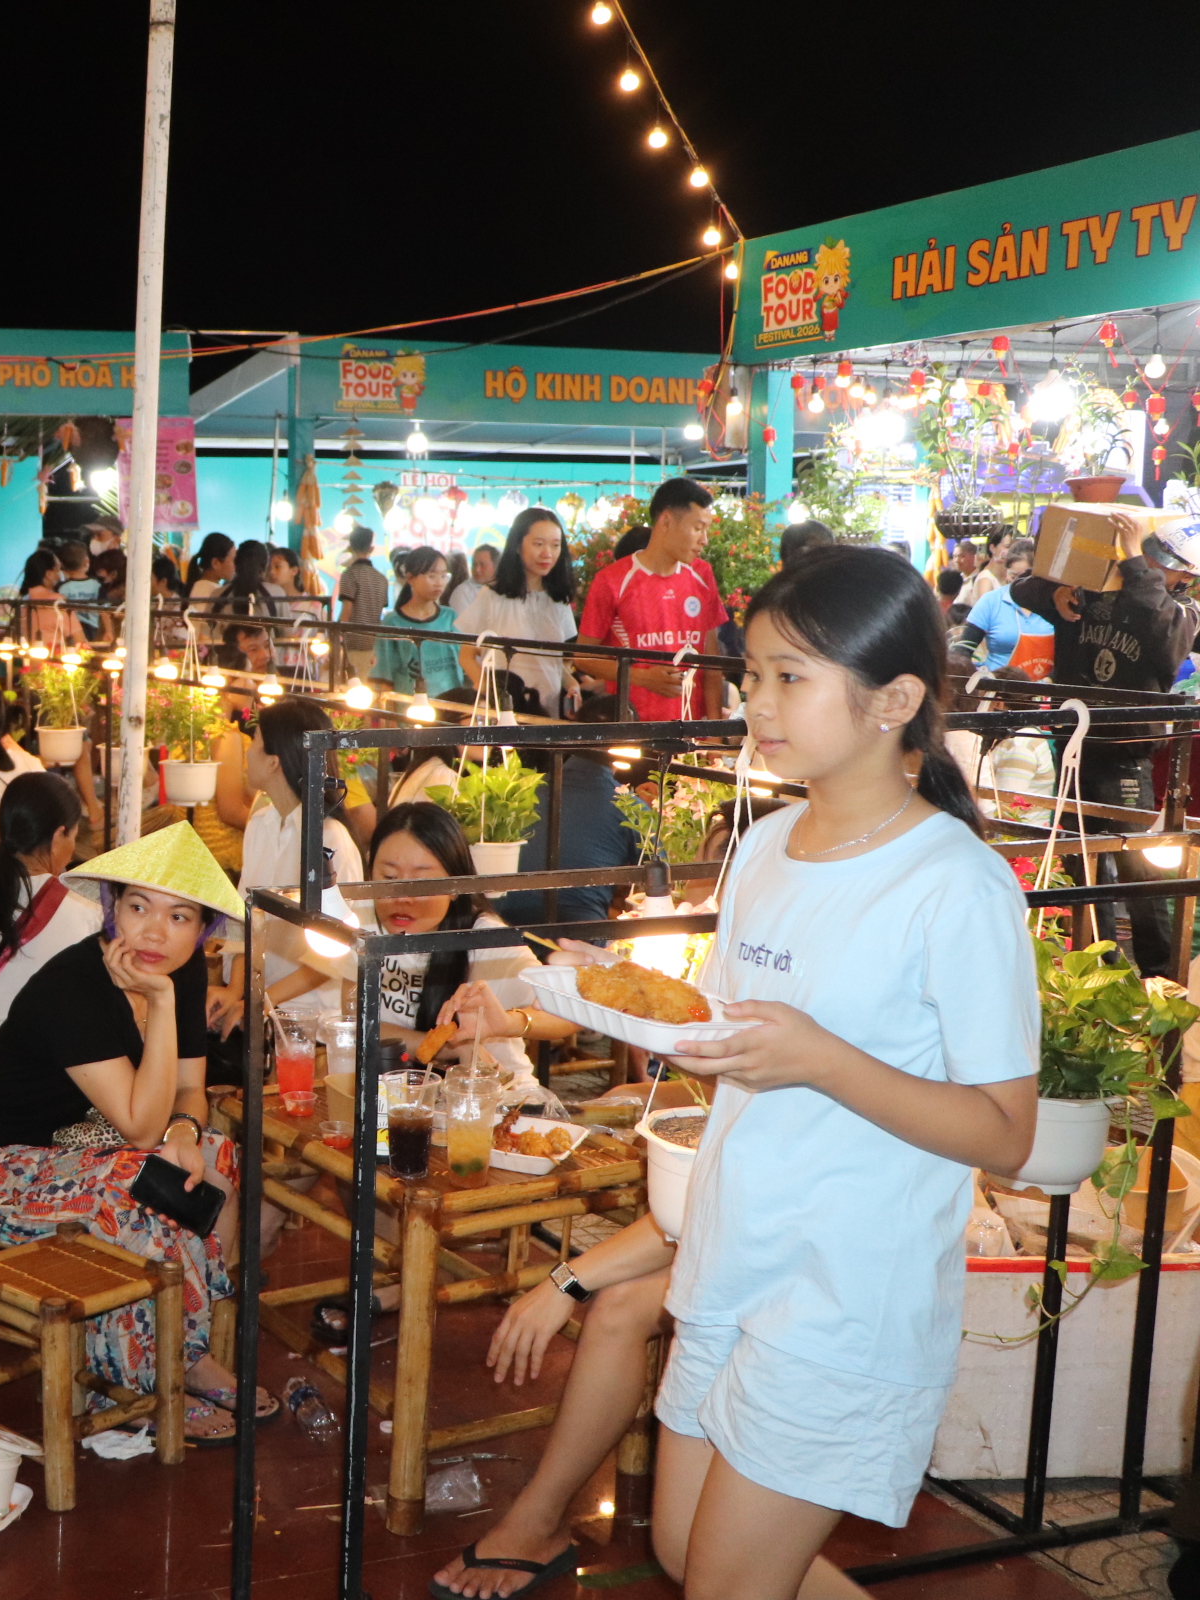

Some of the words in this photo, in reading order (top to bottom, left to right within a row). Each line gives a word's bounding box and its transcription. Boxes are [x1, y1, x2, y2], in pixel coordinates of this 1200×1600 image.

[891, 238, 957, 301] HẢI
[966, 222, 1050, 287] SẢN
[1061, 210, 1122, 271] TY
[1130, 194, 1199, 258] TY
[771, 250, 809, 270] DANANG
[763, 271, 815, 304] FOOD
[763, 297, 815, 329] TOUR
[758, 328, 797, 344] FESTIVAL
[797, 325, 821, 337] 2026
[349, 350, 388, 358] DANANG
[341, 361, 394, 381] FOOD
[342, 381, 394, 399] TOUR
[484, 365, 528, 403] HỘ
[535, 372, 603, 402] KINH
[610, 375, 704, 405] DOANH
[637, 631, 674, 647] KING
[677, 630, 701, 645] LEO
[738, 941, 773, 968] TUYỆT
[773, 949, 792, 974] VỜI
